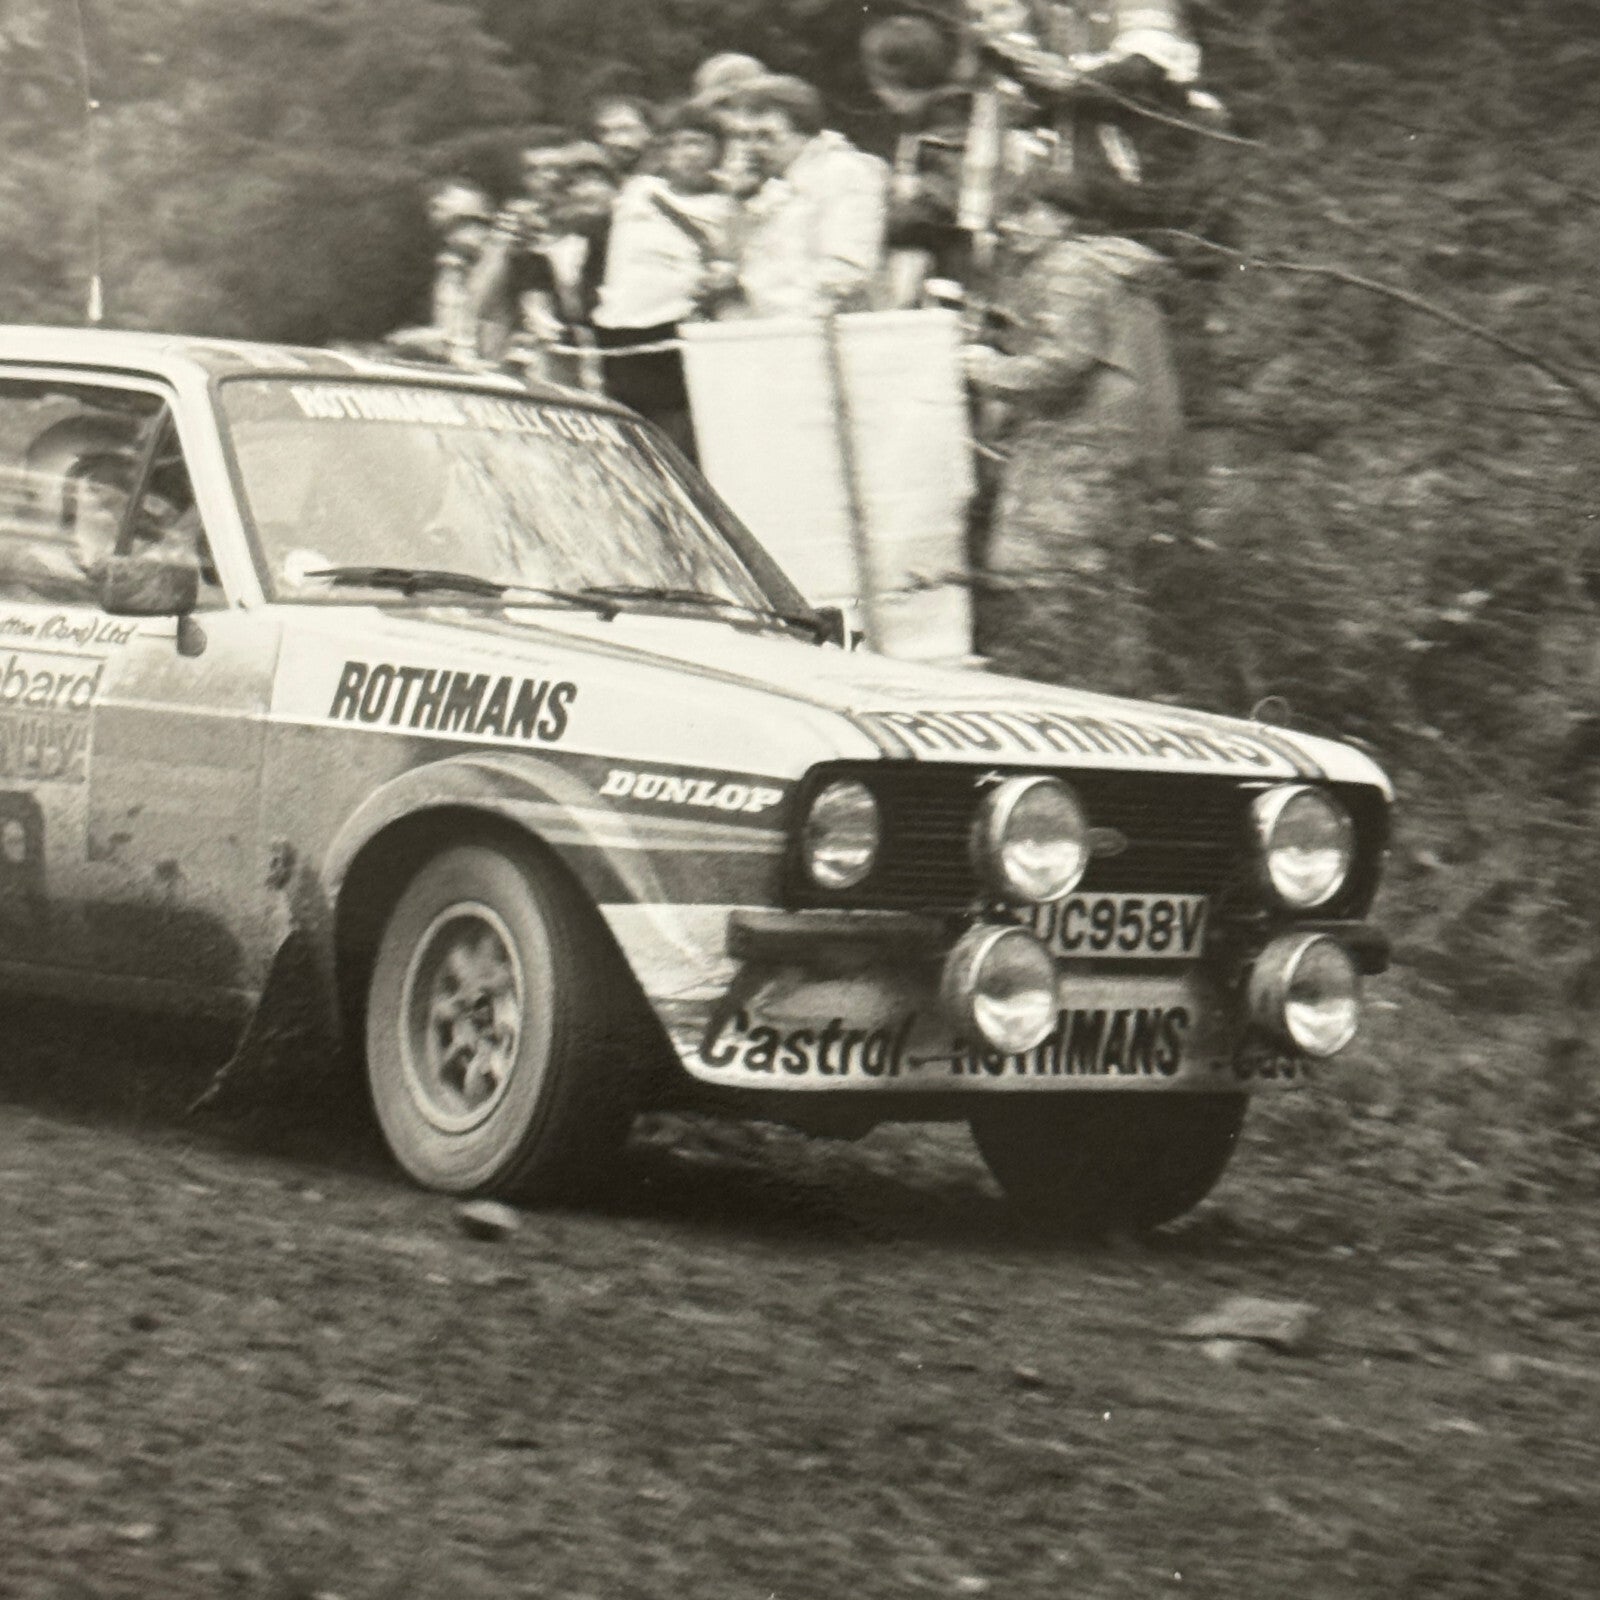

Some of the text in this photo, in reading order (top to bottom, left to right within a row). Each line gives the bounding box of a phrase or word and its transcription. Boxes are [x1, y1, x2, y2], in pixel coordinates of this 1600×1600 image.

[0, 655, 104, 712] bard
[328, 660, 577, 743] ROTHMANS
[600, 769, 785, 814] DUNLOP
[699, 1008, 917, 1077] Castrol
